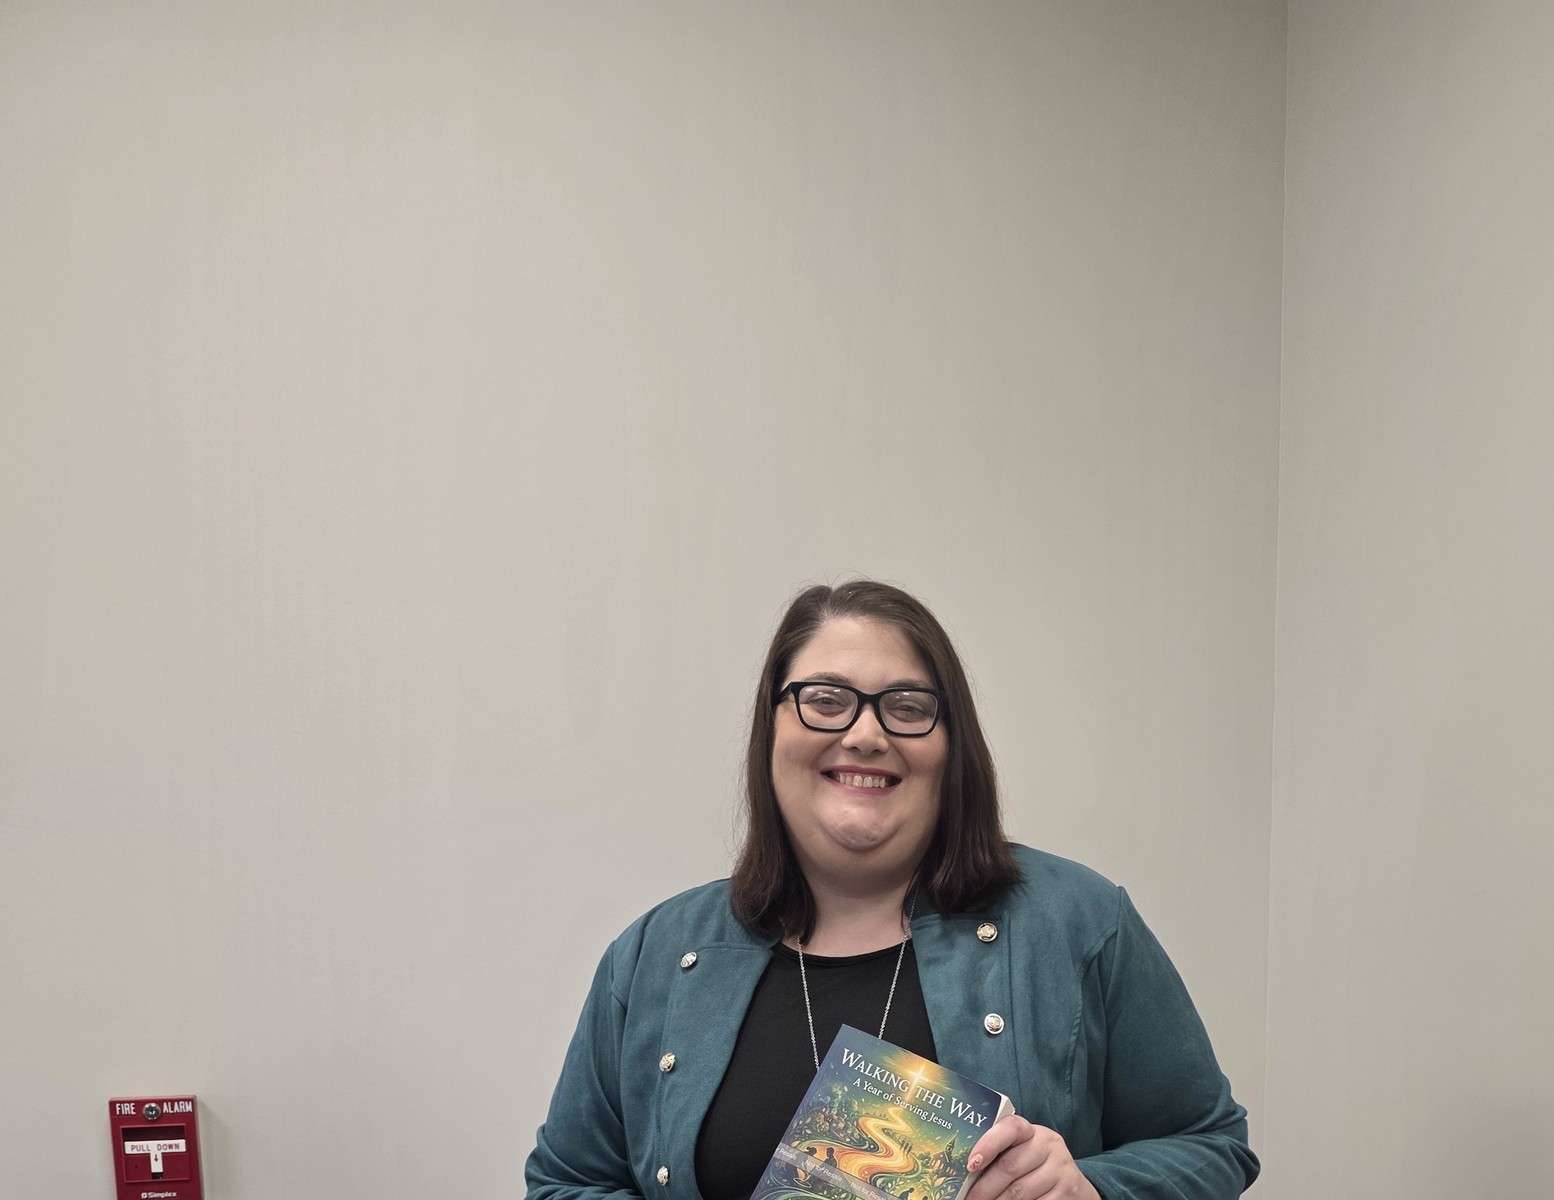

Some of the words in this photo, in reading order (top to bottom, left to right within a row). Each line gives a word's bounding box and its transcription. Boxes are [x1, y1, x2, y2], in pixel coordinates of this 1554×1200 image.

[842, 1049, 911, 1091] WALKING
[915, 1085, 945, 1109] THE
[950, 1097, 987, 1128] WAY
[853, 1079, 861, 1087] A
[863, 1082, 882, 1097] Year
[883, 1091, 893, 1102] of
[894, 1096, 928, 1121] Serving
[928, 1110, 953, 1130] Jesus
[116, 1103, 136, 1115] FIRE
[163, 1101, 192, 1113] ALARM
[131, 1144, 150, 1152] PULL
[157, 1143, 180, 1151] DOWN
